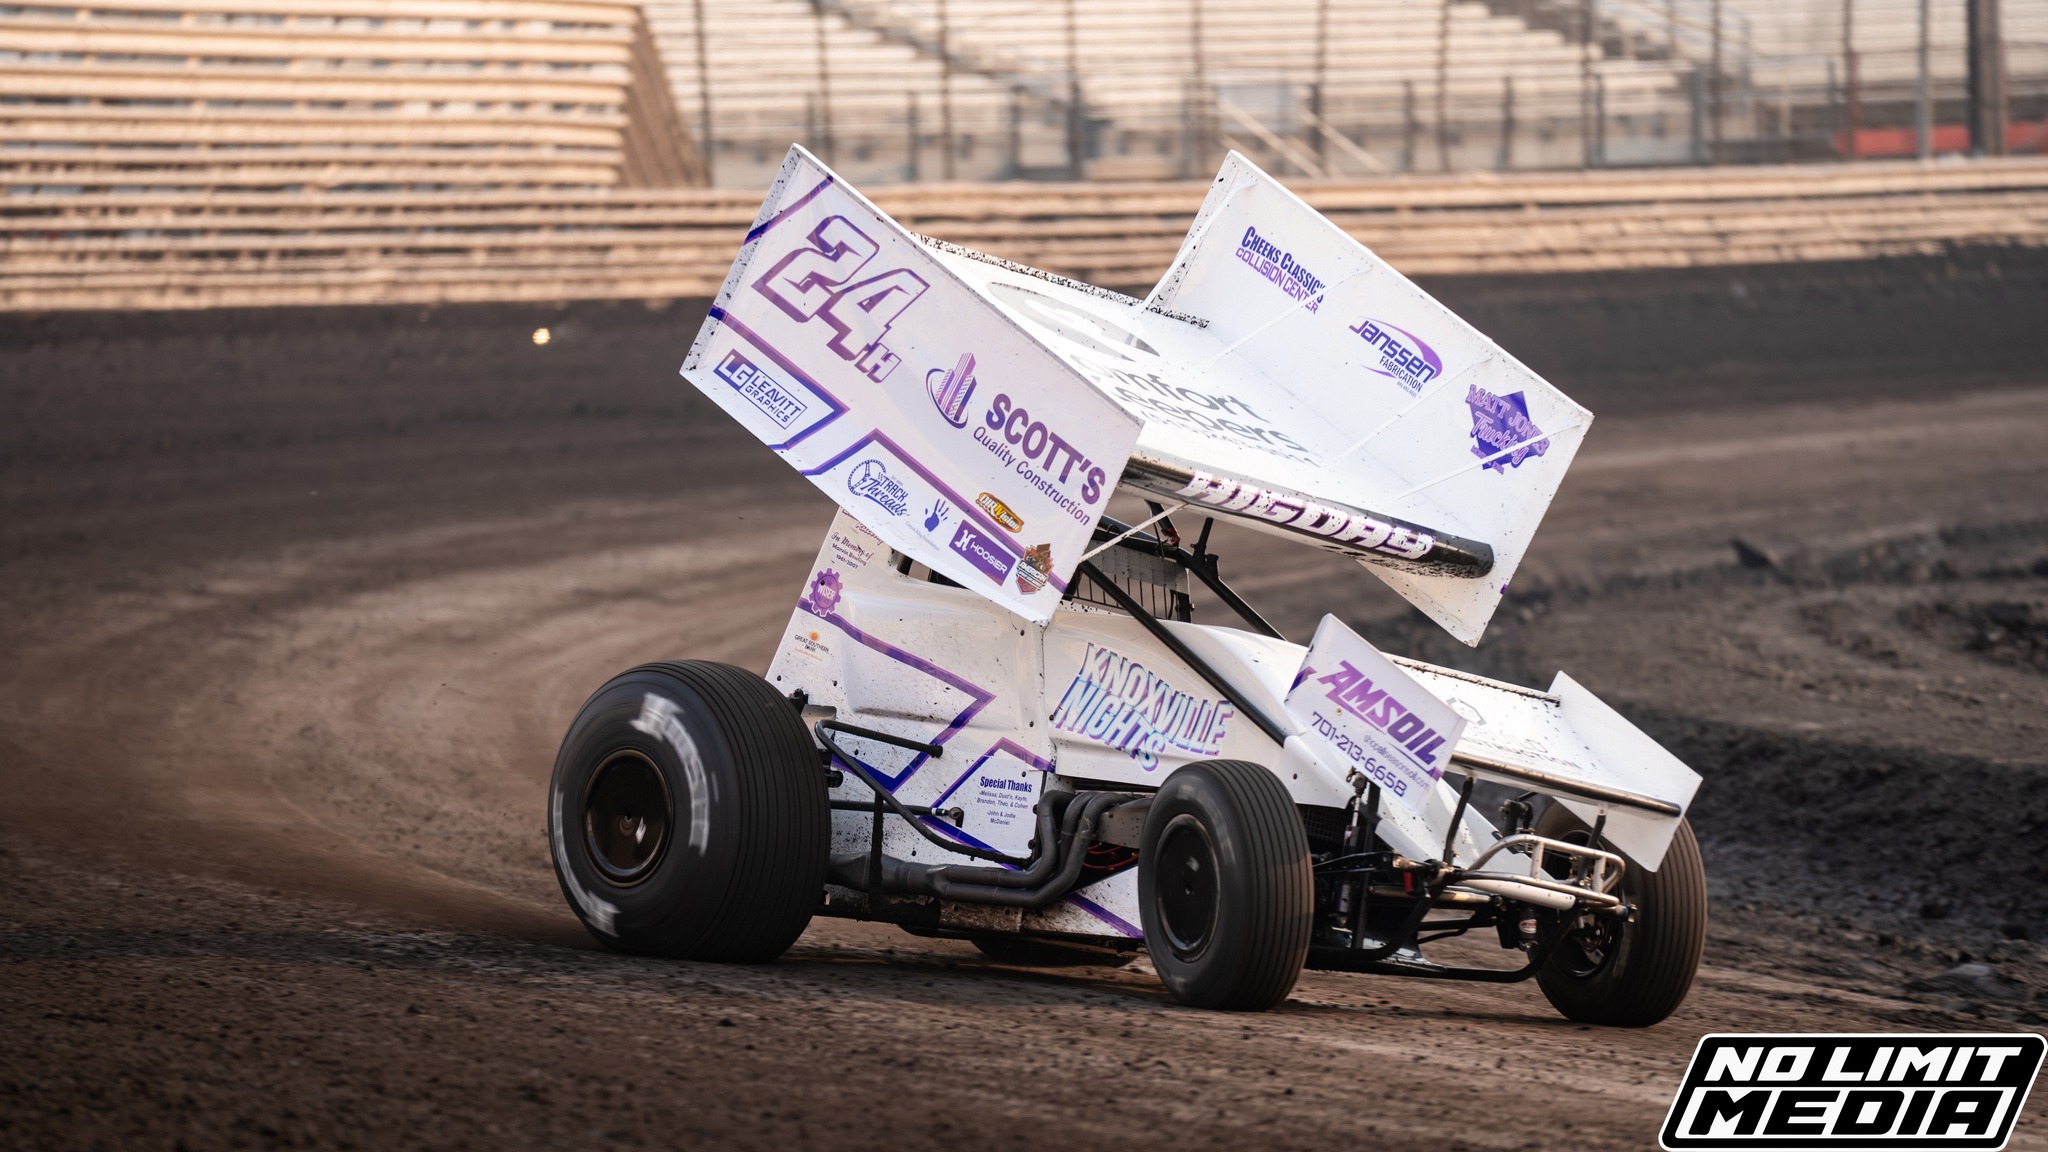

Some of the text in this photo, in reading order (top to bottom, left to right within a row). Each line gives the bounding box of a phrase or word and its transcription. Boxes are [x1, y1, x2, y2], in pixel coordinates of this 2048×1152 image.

[1235, 247, 1287, 288] COLLISION
[718, 354, 755, 388] LG
[1379, 355, 1424, 393] FABRICATION
[744, 385, 790, 423] GRAPHICS
[751, 375, 802, 417] LEAVITT
[1465, 384, 1511, 419] MATT
[985, 393, 1106, 505] SCOTT'S
[880, 475, 909, 503] TRACK
[973, 426, 1091, 527] Quality Construction
[860, 477, 908, 517] Threads
[1175, 470, 1437, 561] HIGDAY
[969, 541, 1008, 575] HOOSIER
[1019, 561, 1047, 583] AMERICAN
[817, 584, 837, 601] WISER
[794, 634, 830, 653] GREAT SOUTHERN
[1079, 642, 1235, 757] KNOXVILLE
[1317, 660, 1447, 766] AMSOIL
[1054, 677, 1166, 772] NIGHTS
[1312, 711, 1408, 798] 701-213-6658
[980, 776, 1032, 793] Special Thanks
